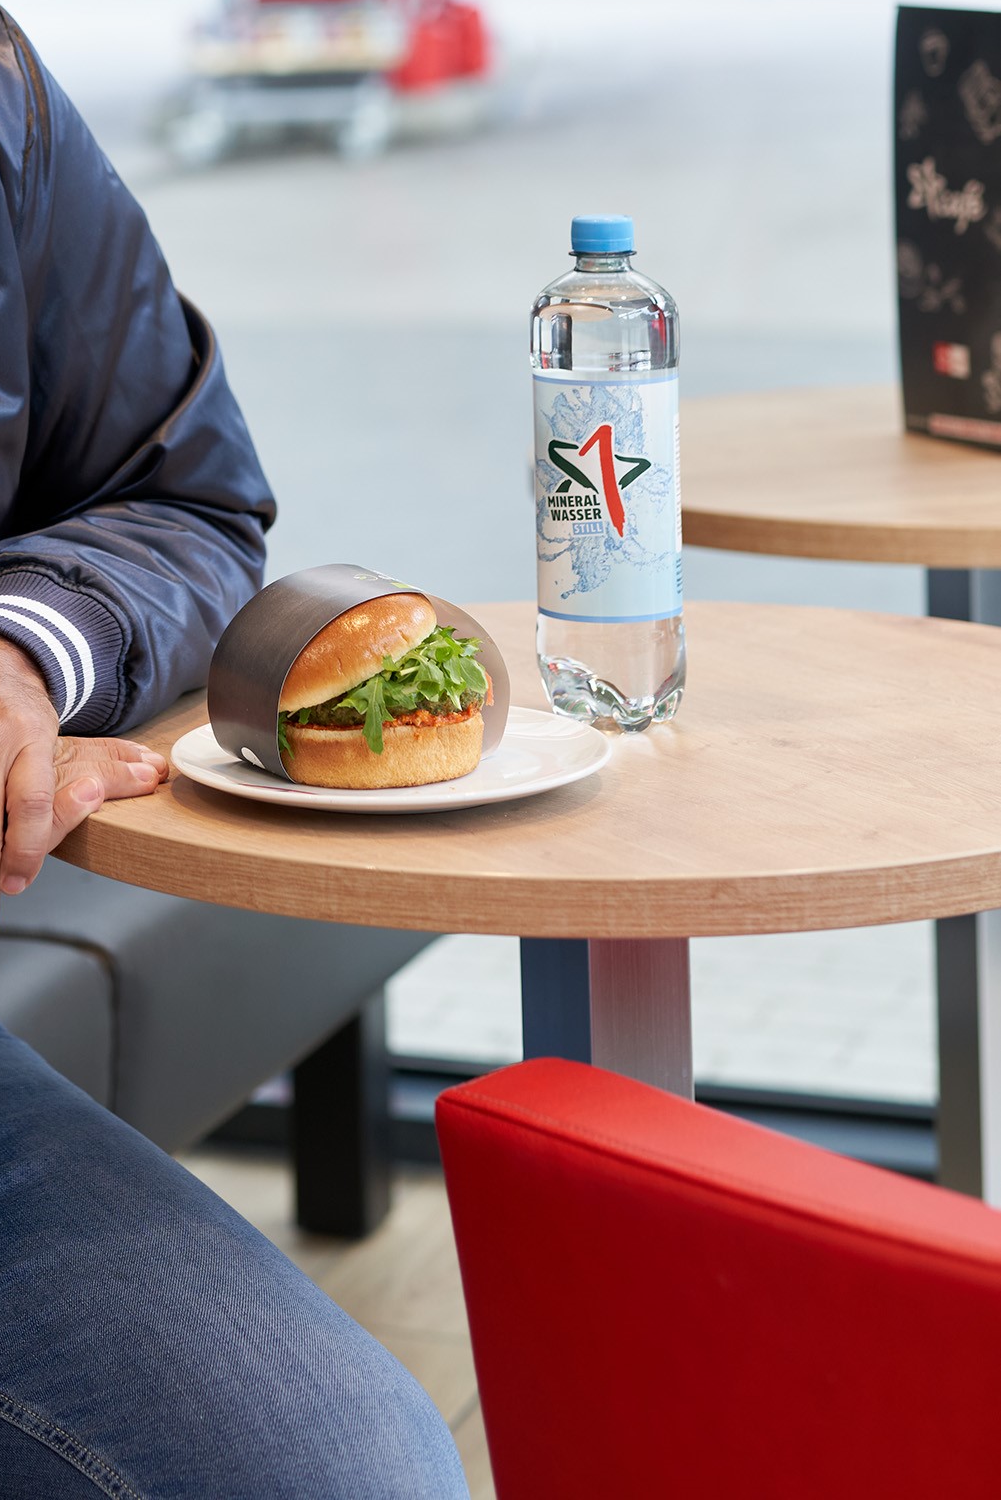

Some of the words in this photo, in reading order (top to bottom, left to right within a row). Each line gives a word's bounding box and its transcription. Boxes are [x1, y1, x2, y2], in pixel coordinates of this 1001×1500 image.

[547, 494, 601, 508] MINERAL
[550, 508, 602, 521] WASSER
[572, 522, 603, 535] STILL
